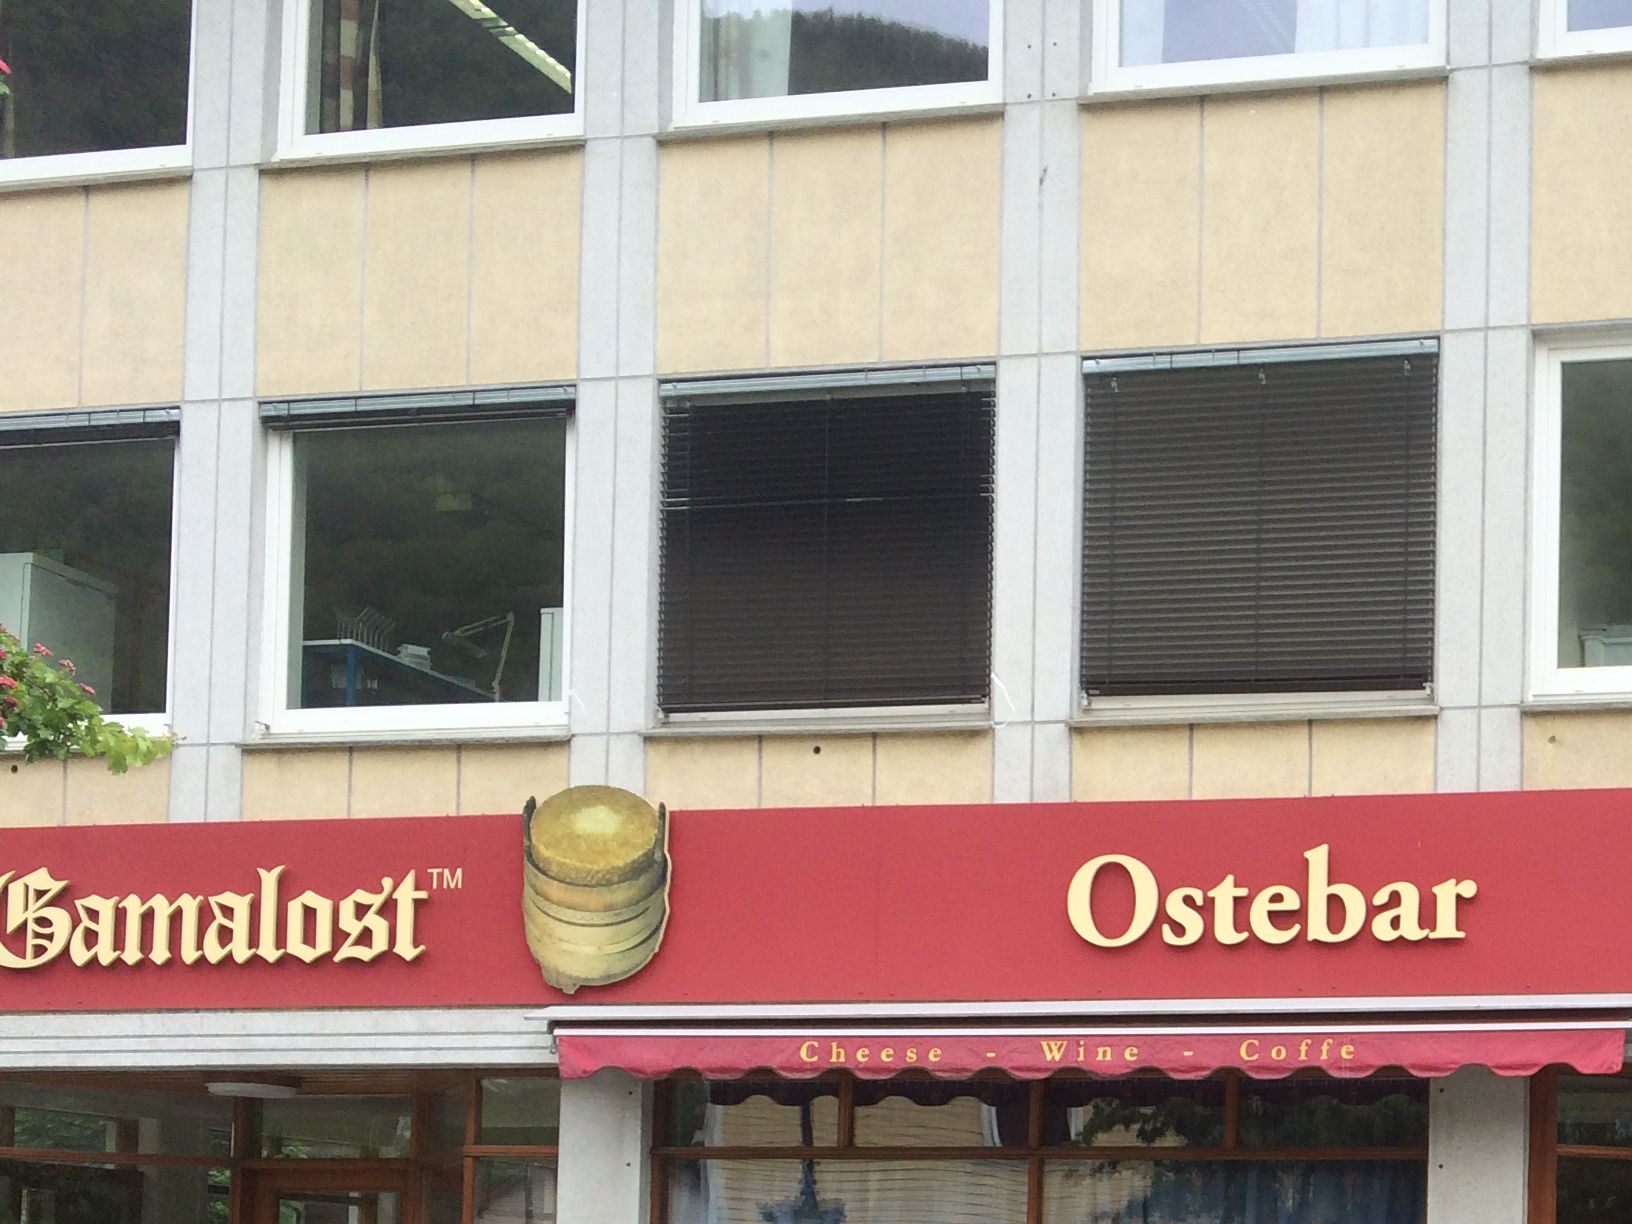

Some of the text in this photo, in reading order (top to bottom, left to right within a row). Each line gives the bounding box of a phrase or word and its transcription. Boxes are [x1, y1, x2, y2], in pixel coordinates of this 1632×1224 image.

[0, 865, 428, 969] Gamalost
[1066, 843, 1478, 949] Ostebar
[799, 1040, 942, 1063] Cheese
[1040, 1039, 1139, 1062] Wine
[1239, 1038, 1356, 1061] Coffe
